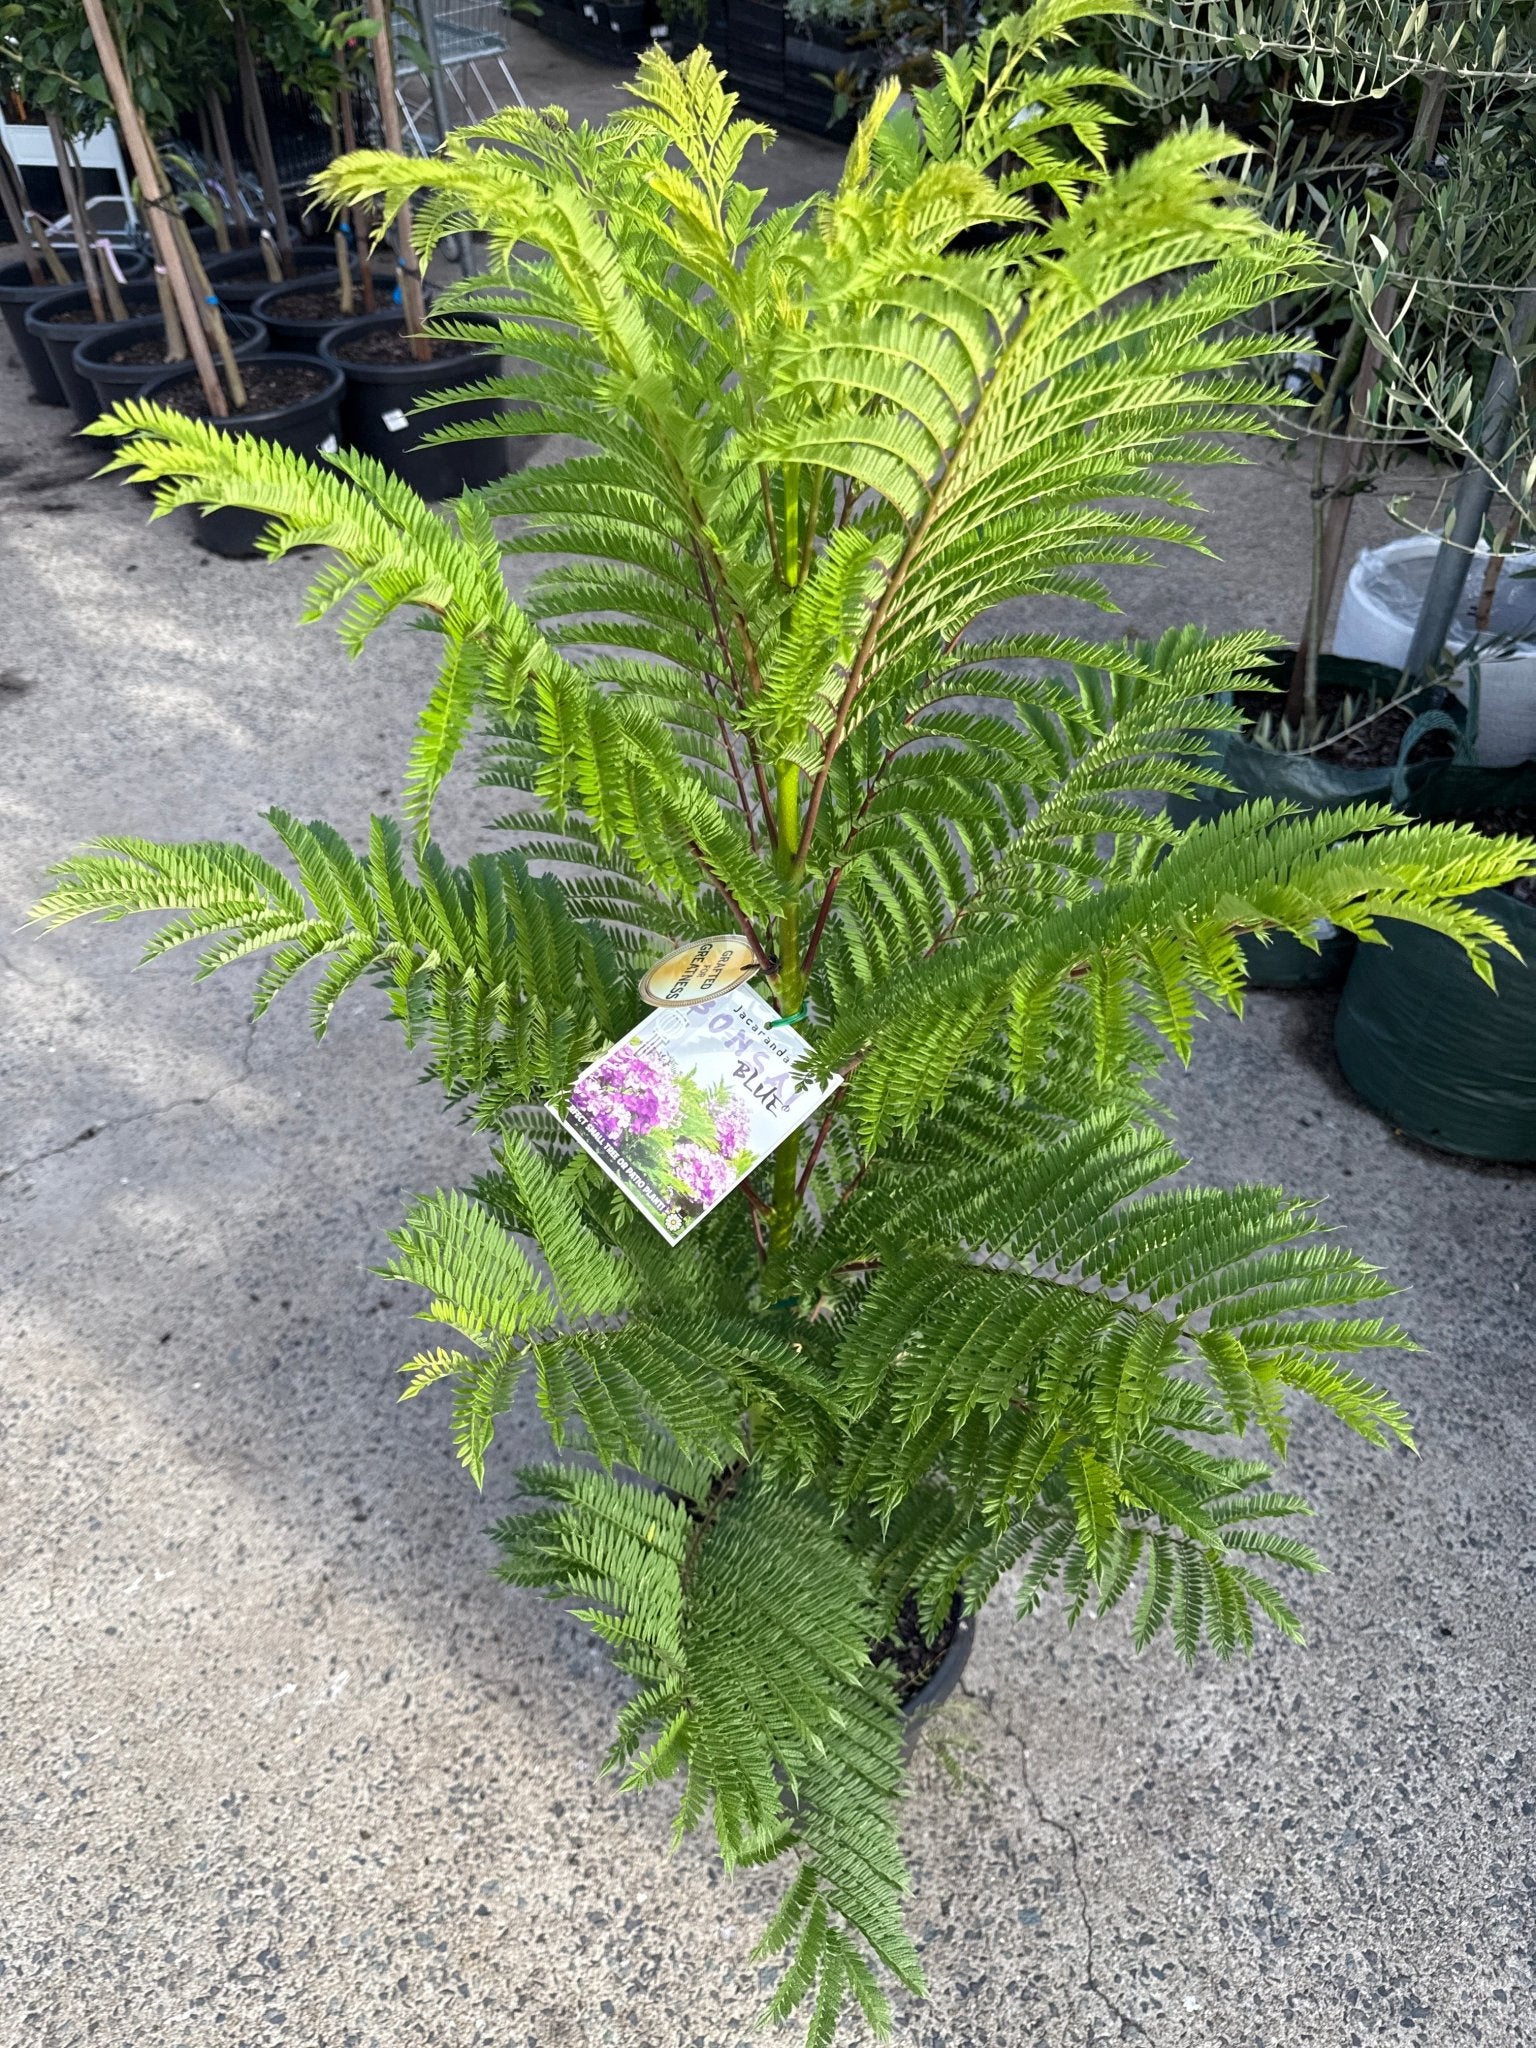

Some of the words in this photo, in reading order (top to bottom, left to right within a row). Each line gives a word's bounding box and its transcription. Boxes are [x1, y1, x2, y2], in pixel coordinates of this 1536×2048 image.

[665, 943, 713, 1000] GREATNESS
[696, 964, 711, 978] FOR
[701, 950, 733, 990] GRAFTED
[733, 1005, 790, 1064] Jacaranda
[585, 1121, 606, 1146] SMALL
[603, 1141, 621, 1161] TREE
[616, 1157, 629, 1171] OR
[625, 1168, 646, 1189] PATIO
[642, 1185, 666, 1211] PLANT!
